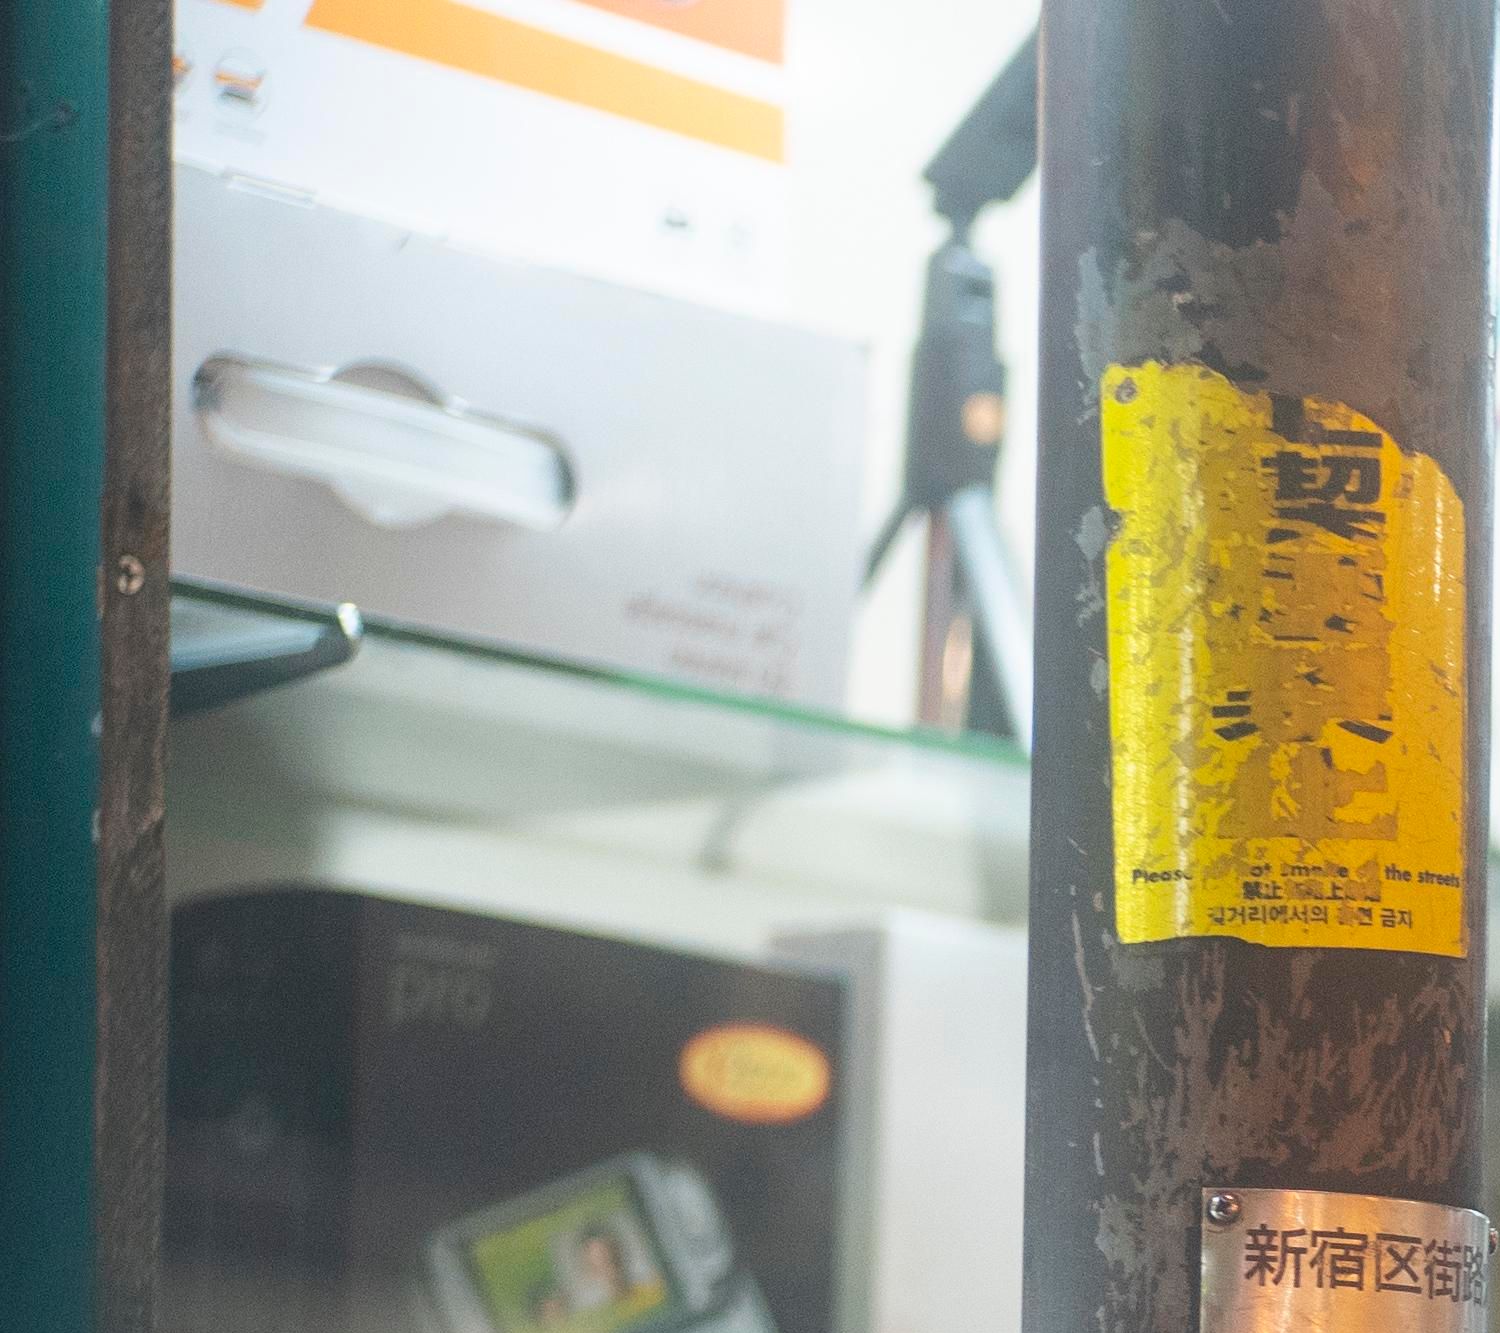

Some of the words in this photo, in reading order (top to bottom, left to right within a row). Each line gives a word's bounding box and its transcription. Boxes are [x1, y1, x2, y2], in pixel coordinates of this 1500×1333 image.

[1385, 863, 1412, 883] the
[1417, 869, 1460, 888] streets
[1380, 907, 1413, 929] 금지
